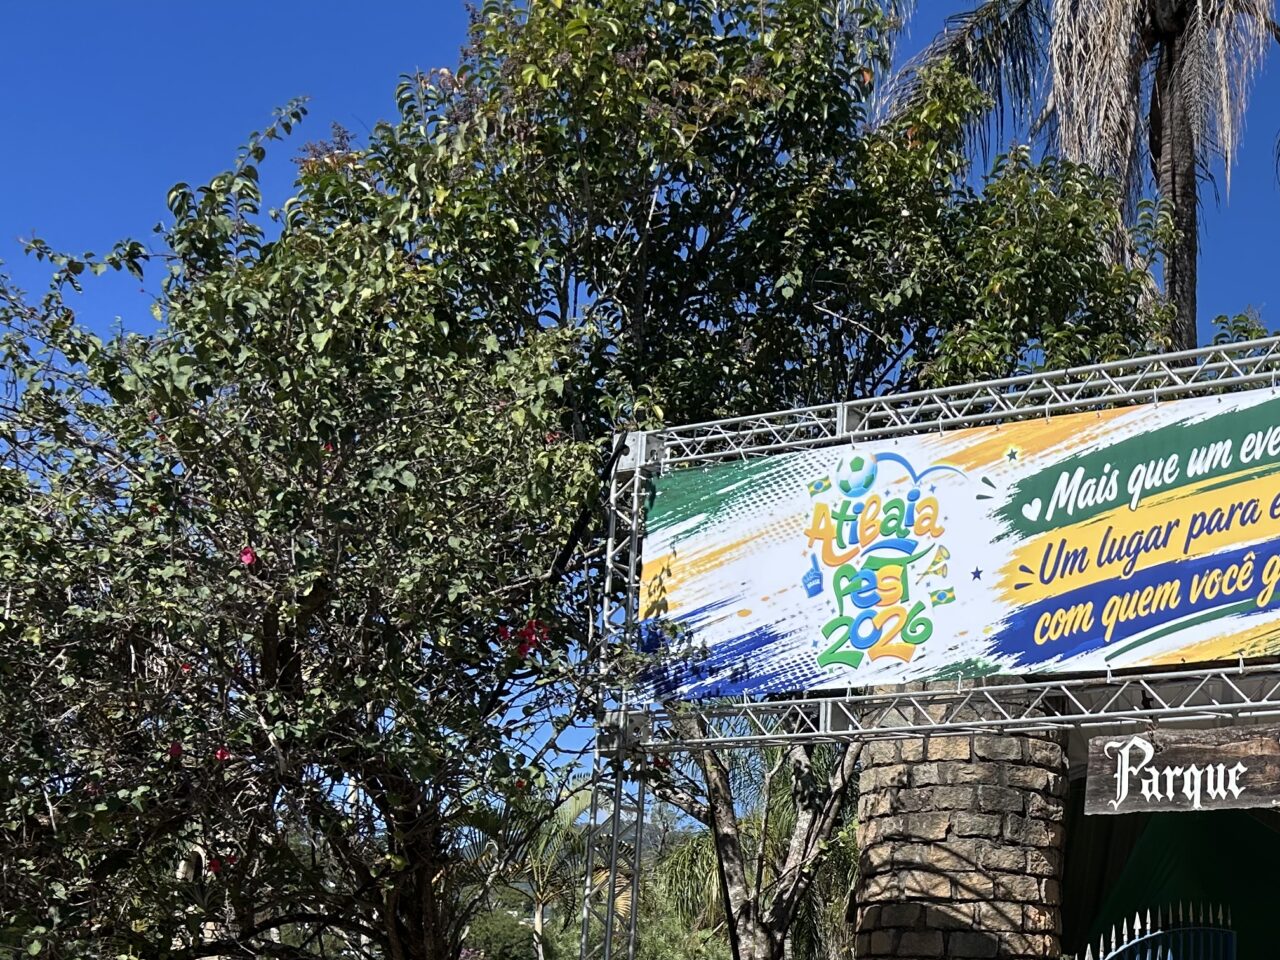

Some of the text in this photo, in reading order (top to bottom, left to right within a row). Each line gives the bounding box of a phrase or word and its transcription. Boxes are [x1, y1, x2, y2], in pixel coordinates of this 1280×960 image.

[1045, 463, 1120, 521] Mais
[1127, 454, 1180, 511] que
[1187, 438, 1232, 477] um
[804, 489, 945, 567] Atibaia
[1039, 539, 1090, 585] Um
[1097, 526, 1180, 577] lugar
[1183, 498, 1262, 554] para
[817, 601, 933, 670] 2026
[1034, 601, 1094, 646] com
[1102, 579, 1181, 642] quem
[1190, 551, 1256, 604] você
[1104, 735, 1248, 812] Parque
